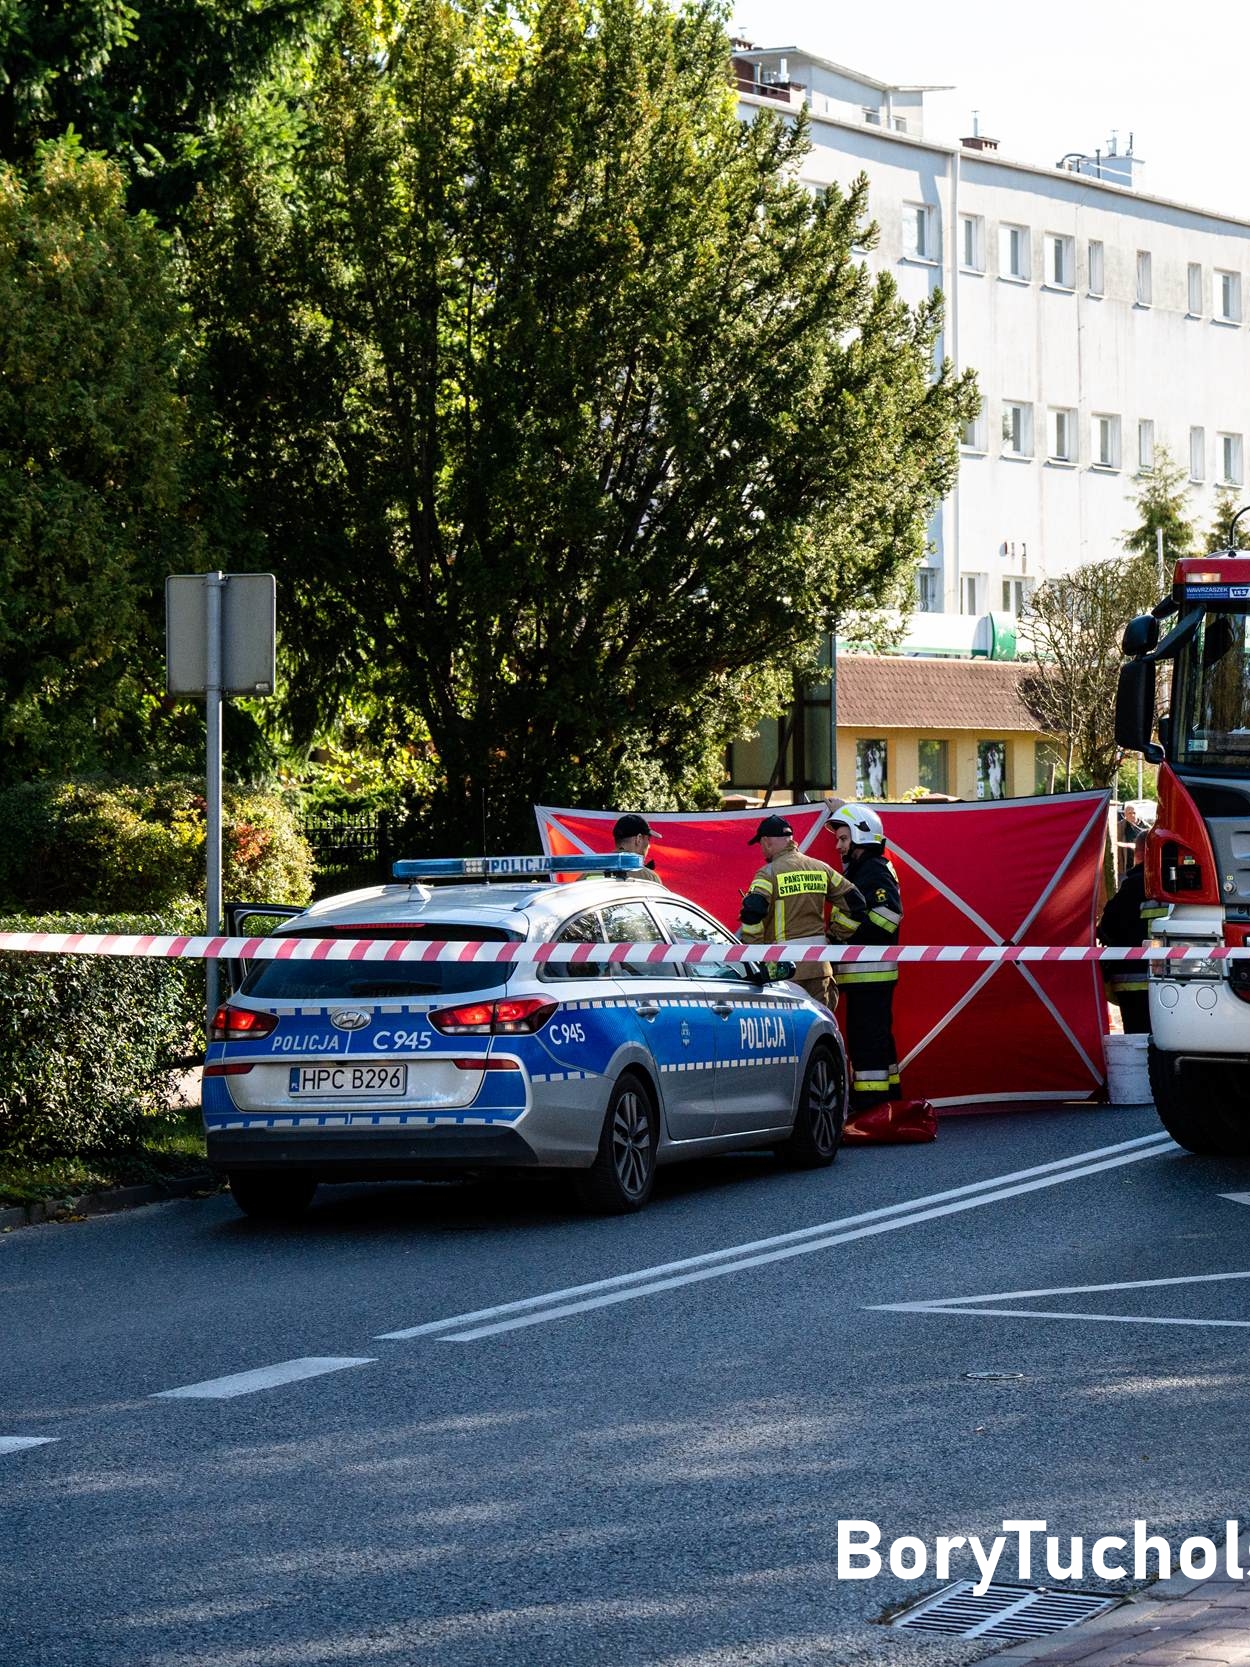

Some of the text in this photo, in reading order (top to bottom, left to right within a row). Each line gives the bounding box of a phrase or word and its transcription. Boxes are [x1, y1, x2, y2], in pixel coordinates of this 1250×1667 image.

[491, 858, 551, 873] POLICJA
[271, 1034, 339, 1051] POLICJA
[739, 1017, 786, 1049] POLICJA
[302, 1068, 400, 1090] HPC B296
